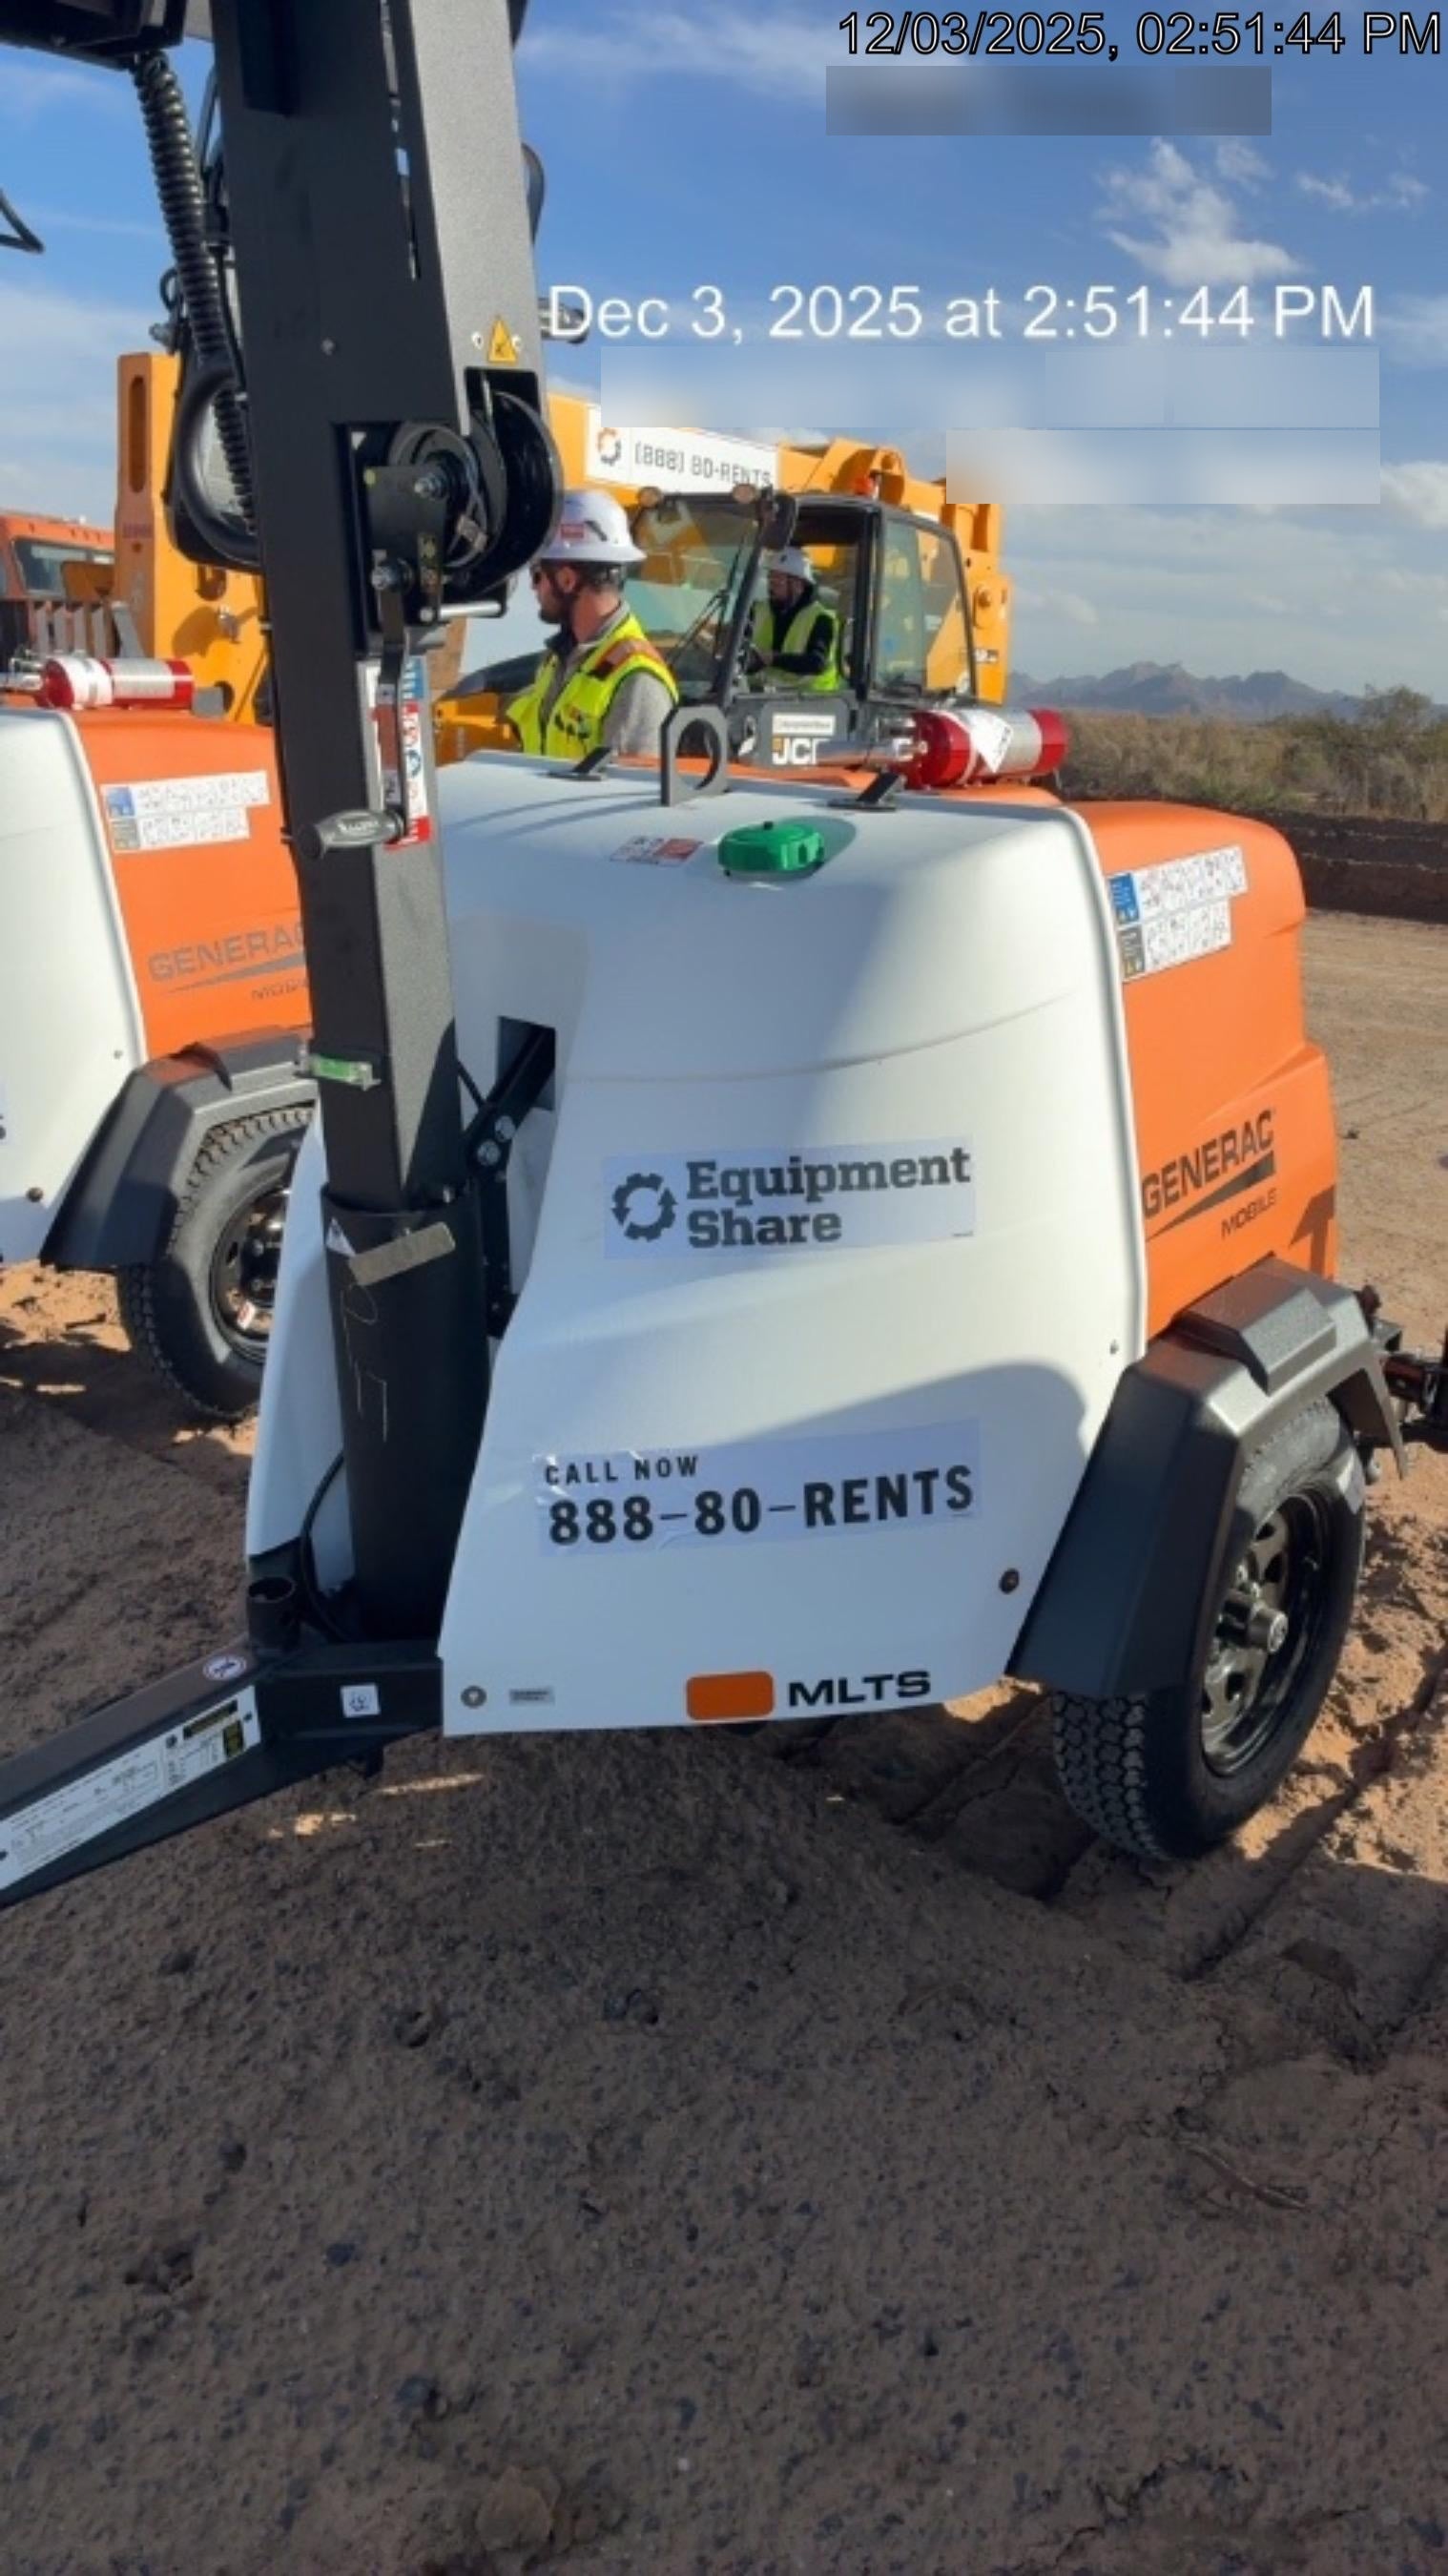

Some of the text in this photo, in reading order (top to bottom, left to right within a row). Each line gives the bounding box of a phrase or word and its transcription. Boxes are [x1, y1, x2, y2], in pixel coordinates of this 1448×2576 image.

[687, 1147, 972, 1206] Equipment
[1142, 1109, 1274, 1219] GENERAC
[687, 1207, 842, 1249] Share
[1220, 1188, 1277, 1238] MOBILE
[545, 1455, 698, 1486] CALL NOW
[548, 1464, 974, 1545] 888-80-RENTS
[788, 1670, 932, 1707] MLTS
